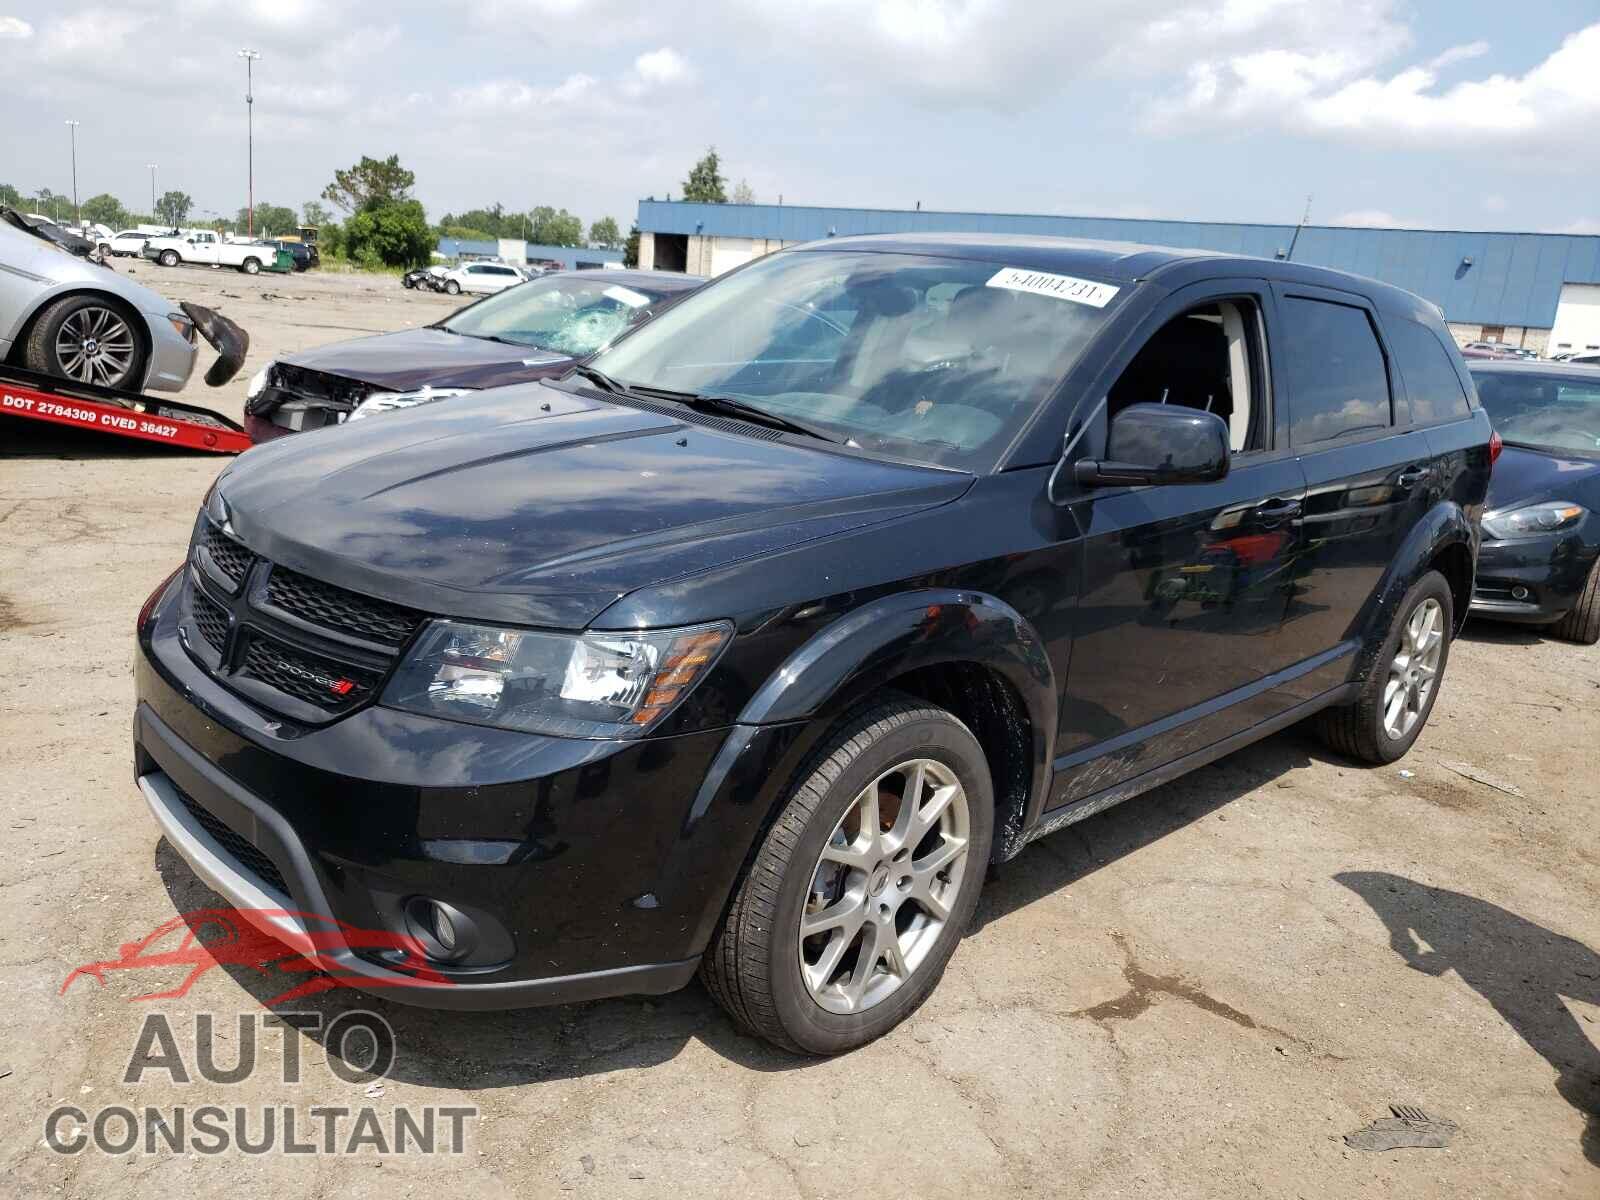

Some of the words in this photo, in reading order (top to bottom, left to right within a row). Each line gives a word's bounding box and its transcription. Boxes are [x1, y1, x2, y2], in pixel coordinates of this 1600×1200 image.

[3, 394, 35, 410] DOT
[37, 401, 97, 422] 2784309
[101, 414, 137, 430] CVED
[140, 421, 178, 437] 36427
[278, 659, 343, 691] DODGE
